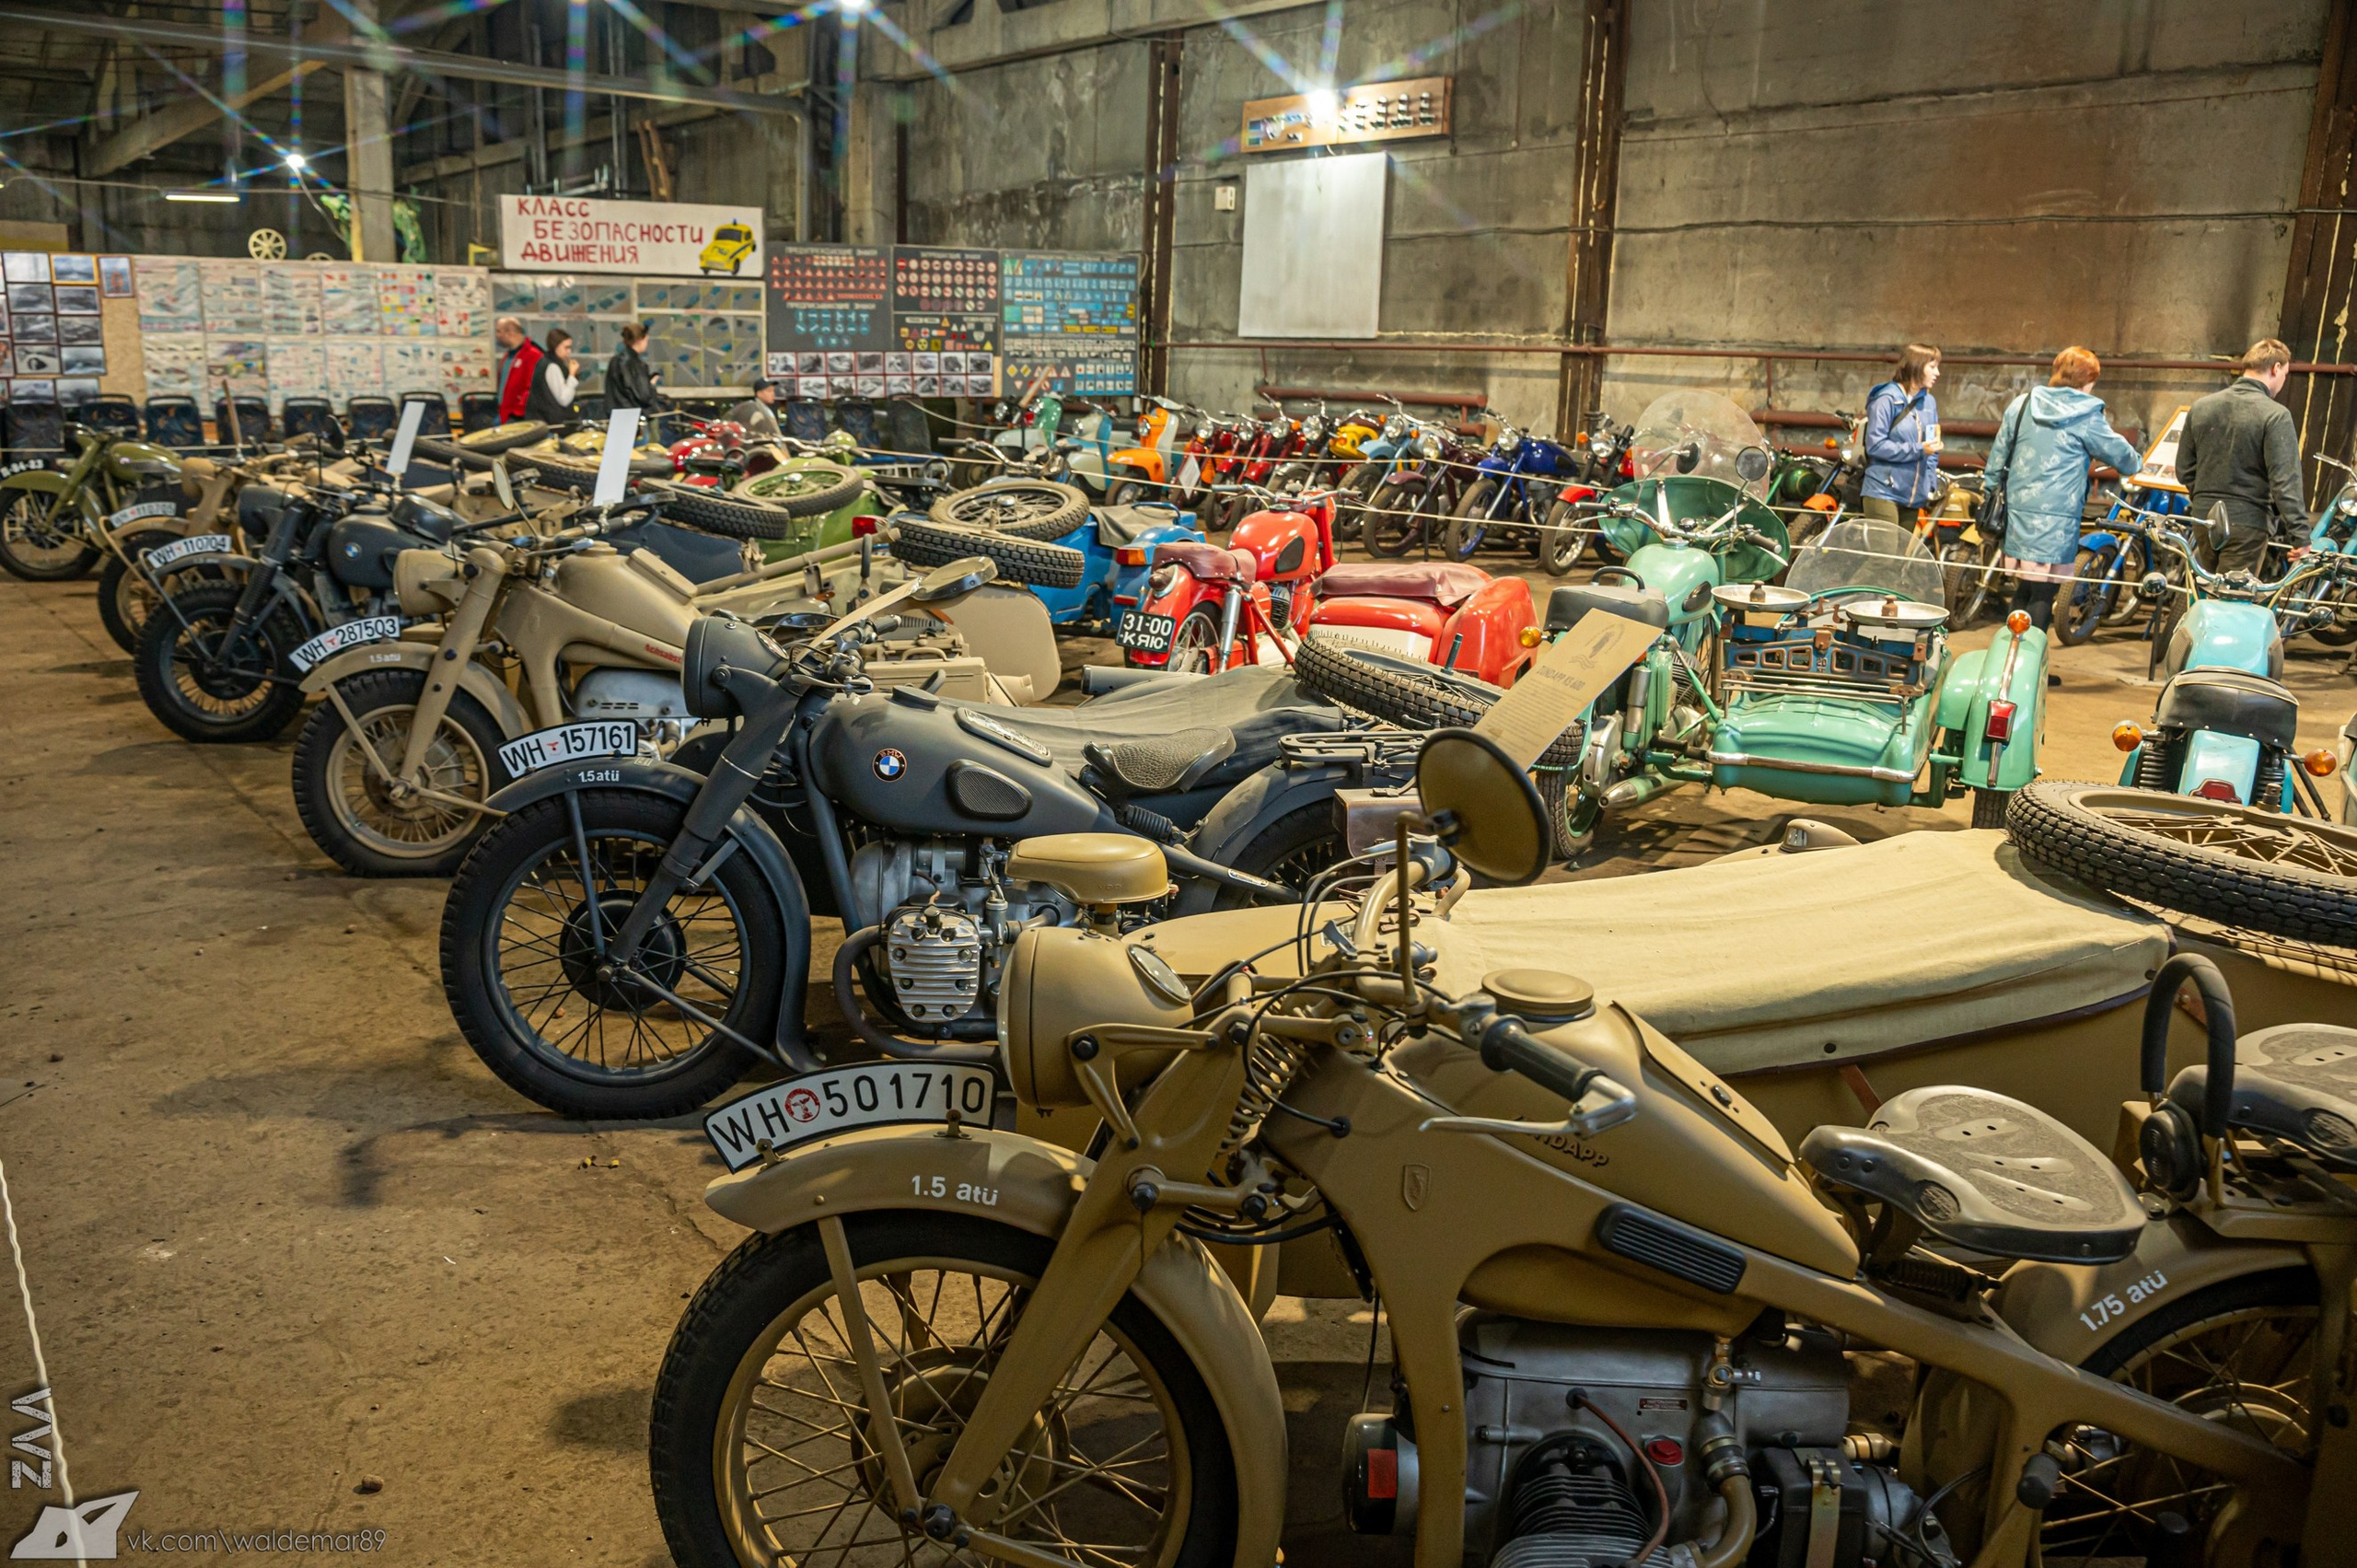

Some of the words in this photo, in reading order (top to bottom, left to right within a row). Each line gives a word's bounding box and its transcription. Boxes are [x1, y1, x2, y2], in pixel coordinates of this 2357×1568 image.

[517, 198, 589, 216] КЛАСС
[533, 219, 703, 244] БЕЗОПАСНОСТИ
[521, 241, 639, 264] ДВИЖЕНИЯ
[152, 546, 176, 564] WH
[183, 536, 226, 553] 110704
[1123, 613, 1173, 636] 31-00
[296, 638, 328, 663] WH
[335, 618, 397, 645] 287503
[1122, 631, 1164, 649] КЯЮ
[502, 738, 547, 772] WH
[559, 725, 632, 754] 157161
[879, 749, 902, 759] BMW
[596, 770, 620, 782] atü
[711, 1097, 791, 1153] WH
[821, 1072, 985, 1118] 501710
[911, 1175, 946, 1198] 1.5
[956, 1182, 999, 1207] atü
[2079, 1293, 2125, 1331] 1.75
[2126, 1270, 2168, 1304] atü
